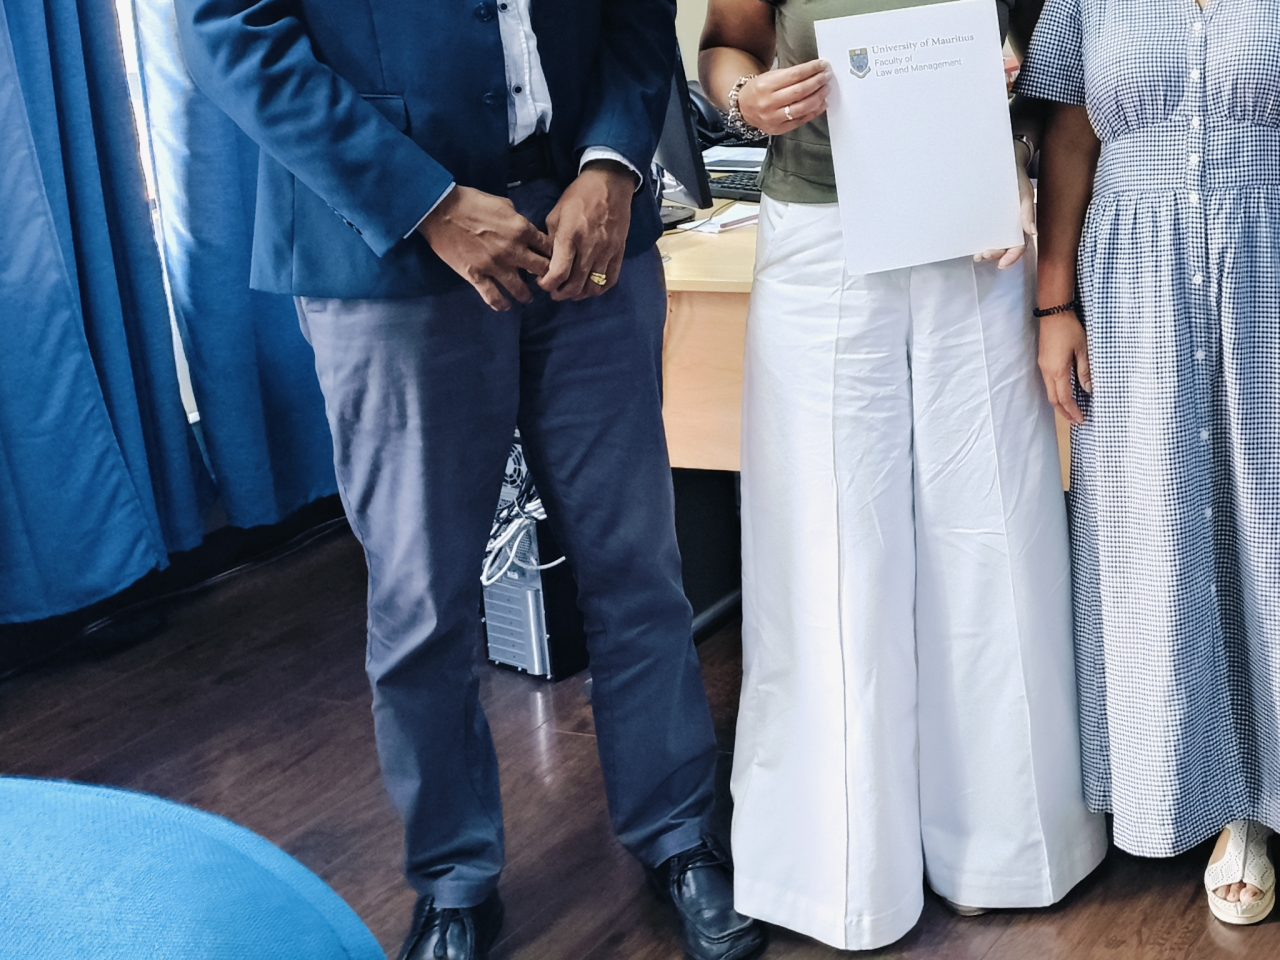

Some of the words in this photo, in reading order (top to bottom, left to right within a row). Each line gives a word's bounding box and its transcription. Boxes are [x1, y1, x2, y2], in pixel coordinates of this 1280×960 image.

[872, 41, 917, 54] University
[919, 38, 930, 48] of
[931, 34, 974, 46] Mauritius
[874, 56, 903, 67] Faculty
[876, 68, 892, 77] Law
[895, 66, 909, 75] and
[911, 58, 962, 72] Management
